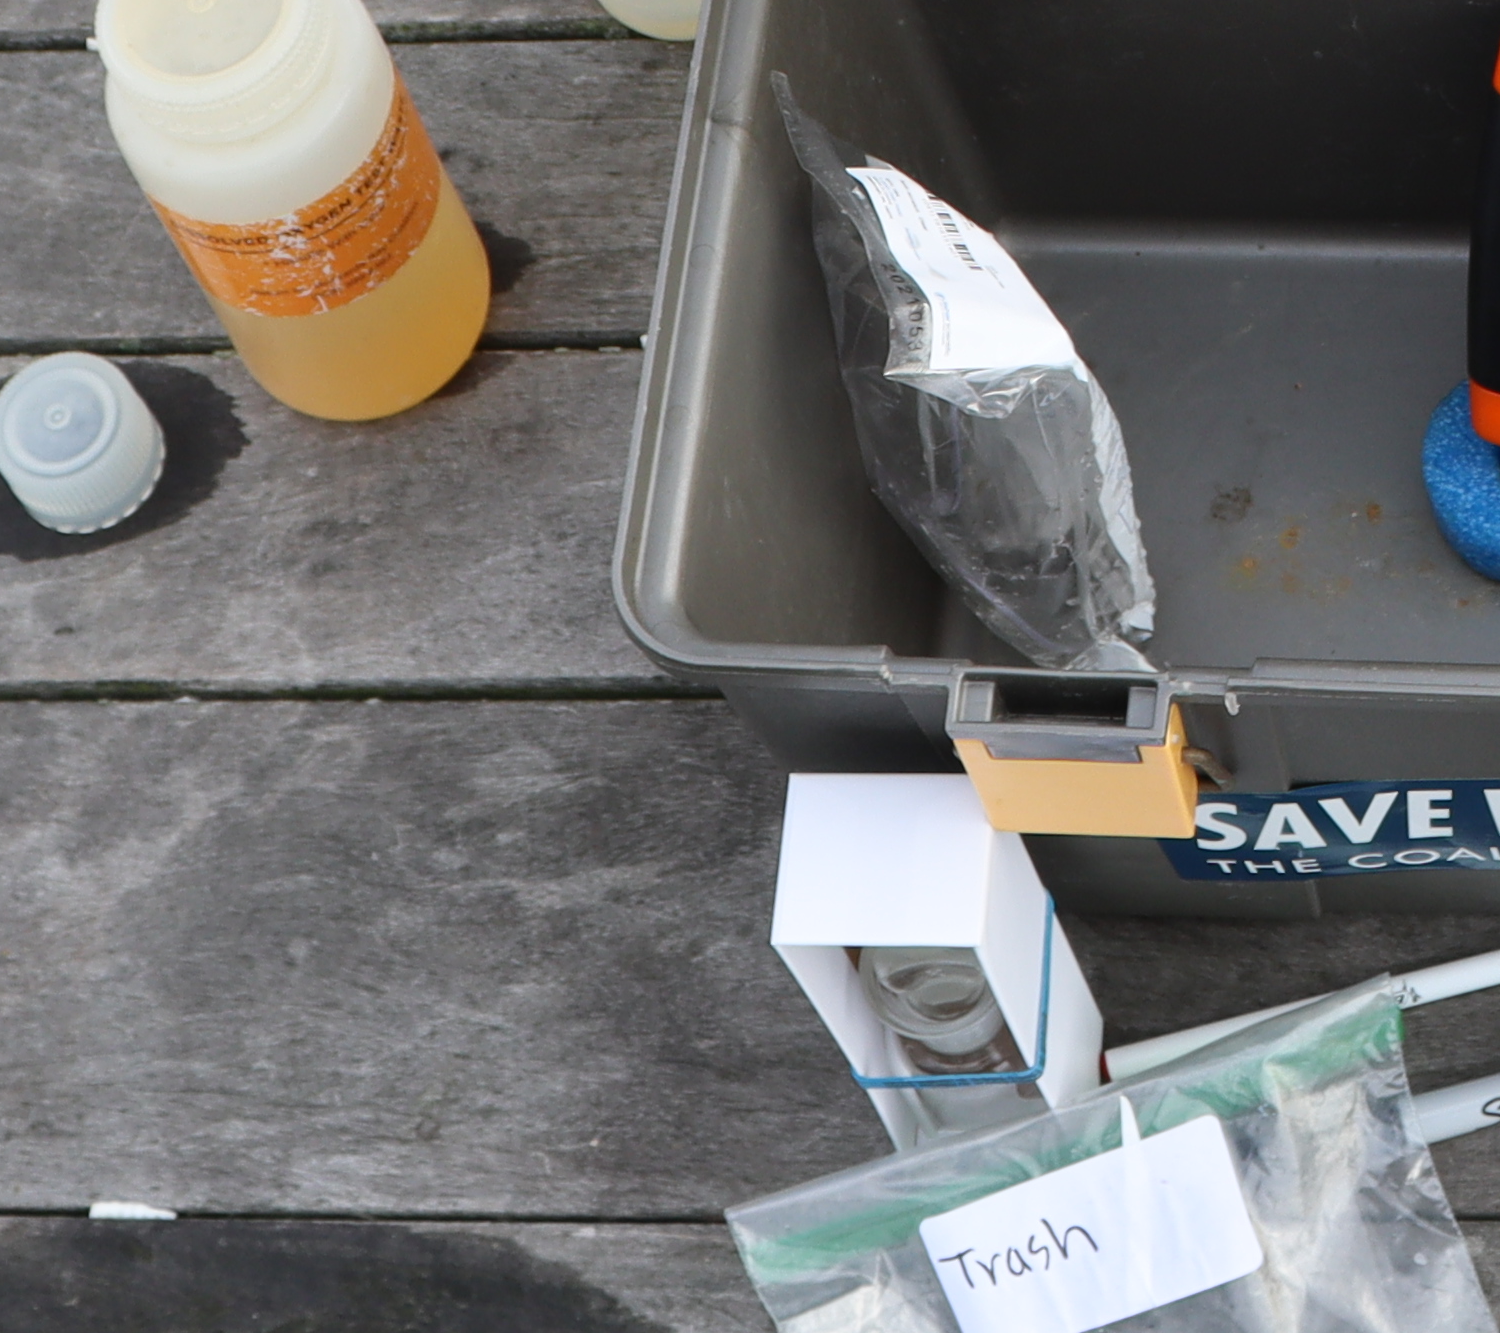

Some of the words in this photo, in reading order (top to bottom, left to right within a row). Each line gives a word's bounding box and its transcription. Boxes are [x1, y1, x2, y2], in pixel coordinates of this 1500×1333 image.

[1196, 788, 1453, 852] SAVE
[1206, 857, 1322, 876] THE
[937, 1217, 1099, 1291] Trash
